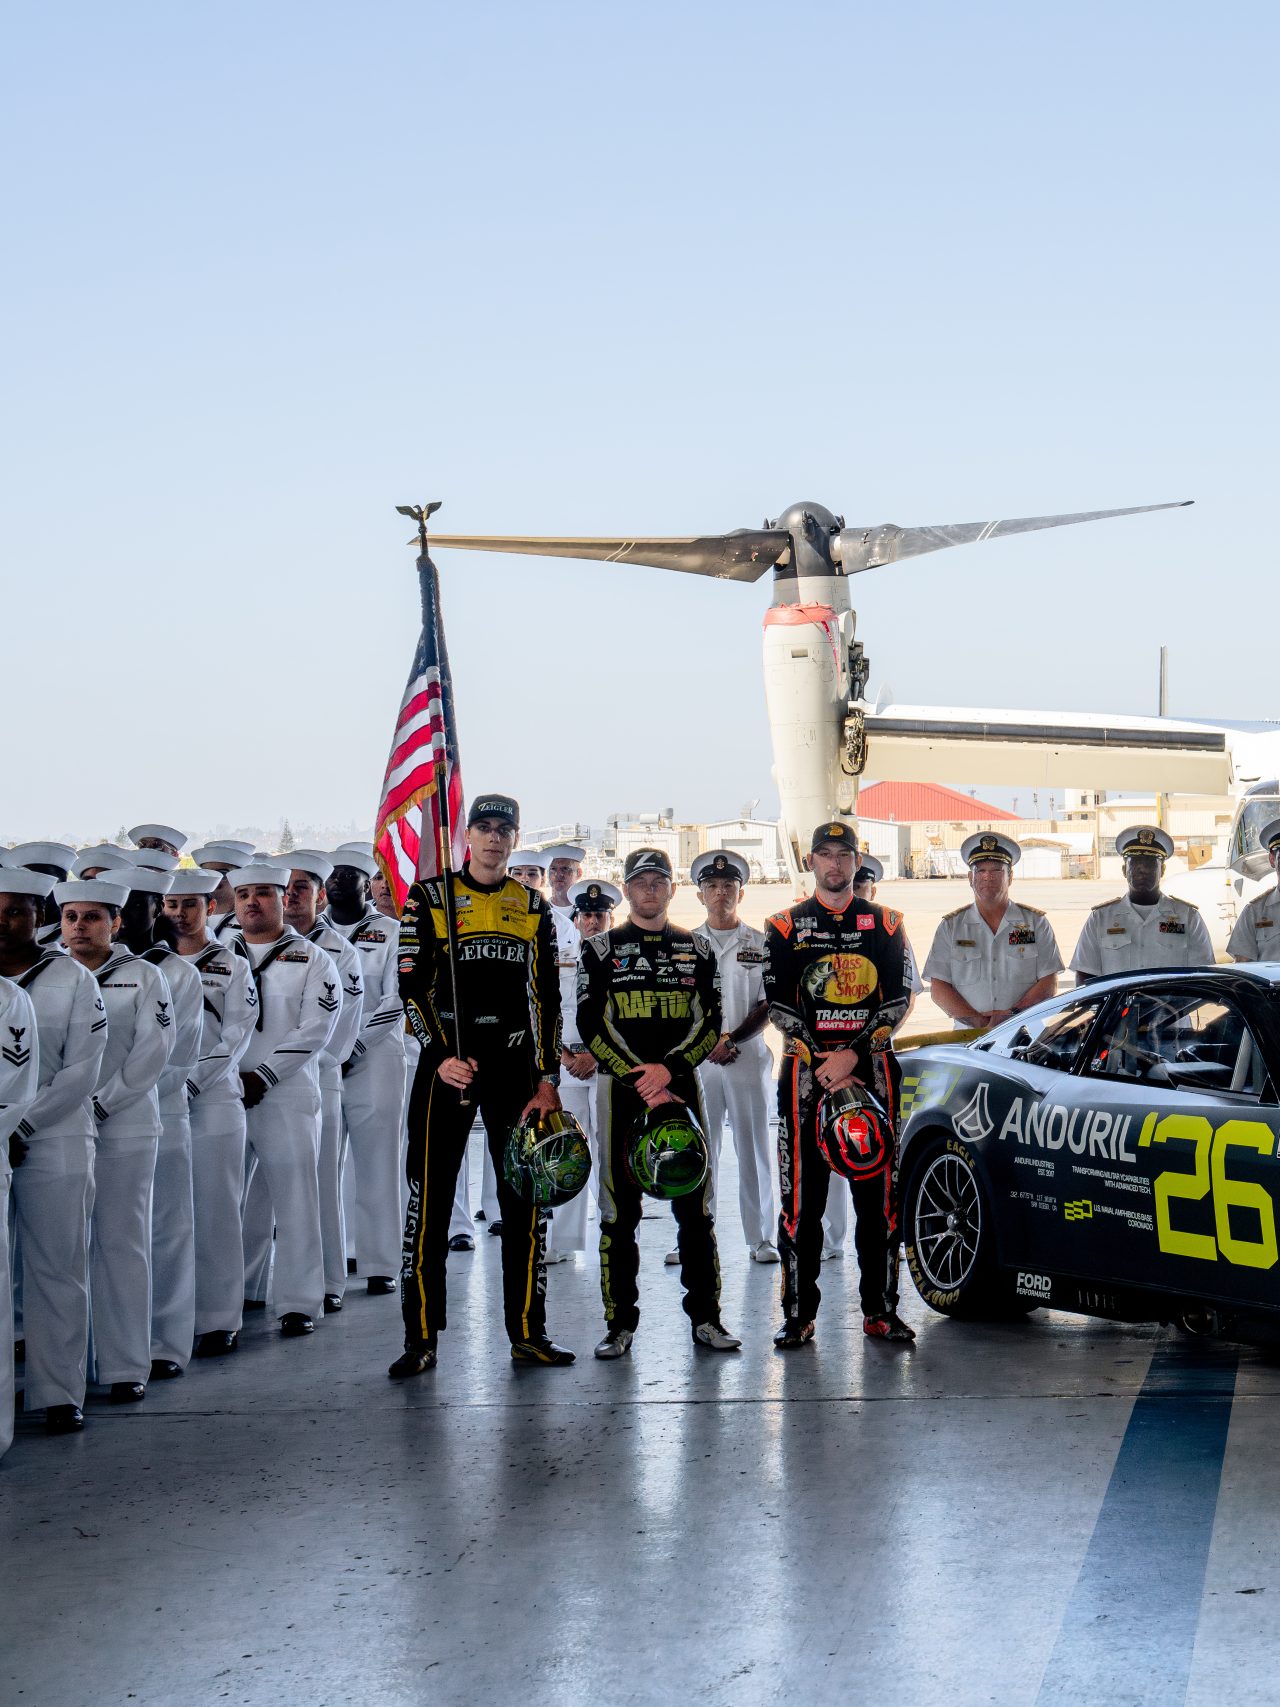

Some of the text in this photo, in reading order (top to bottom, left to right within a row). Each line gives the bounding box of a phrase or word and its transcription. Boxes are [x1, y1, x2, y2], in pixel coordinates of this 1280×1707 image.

[478, 801, 513, 815] ZEIGLER
[614, 990, 692, 1019] RAPTOR
[815, 1009, 869, 1021] TRACKER
[508, 1030, 526, 1048] 77
[998, 1096, 1138, 1164] ANDURIL
[946, 1139, 976, 1169] EAGLE
[1127, 1219, 1154, 1231] CORONADO
[1016, 1271, 1052, 1291] FORD
[1016, 1287, 1051, 1299] PERFORMANCE
